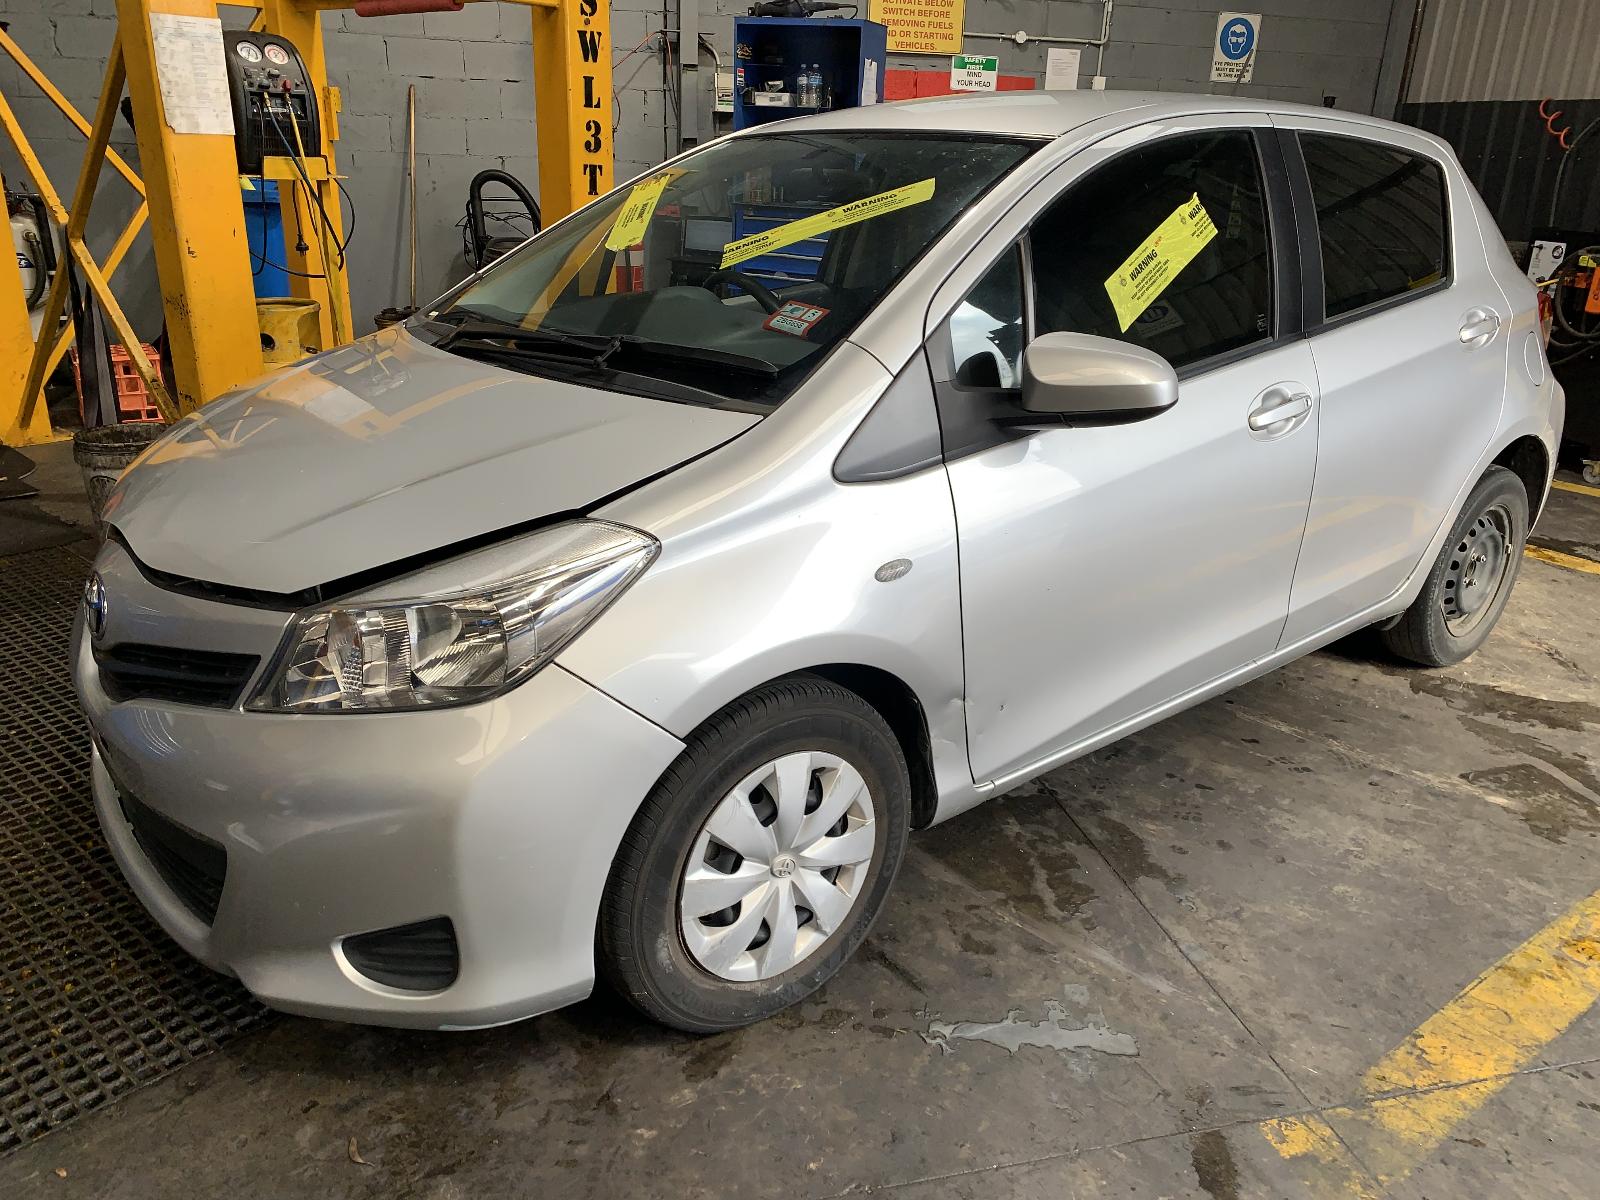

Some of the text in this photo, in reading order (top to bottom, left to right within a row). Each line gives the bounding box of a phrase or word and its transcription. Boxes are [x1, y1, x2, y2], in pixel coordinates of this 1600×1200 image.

[925, 0, 954, 8] BELOW
[882, 7, 951, 19] SWITCH BEFORE
[881, 18, 954, 30] REMOVING FUELS
[886, 29, 954, 41] ND OR STARTING
[894, 40, 938, 51] VEHICLES.
[956, 79, 991, 88] YOUR HEAD
[842, 193, 898, 213] WARNING
[1129, 248, 1158, 281] WARNING
